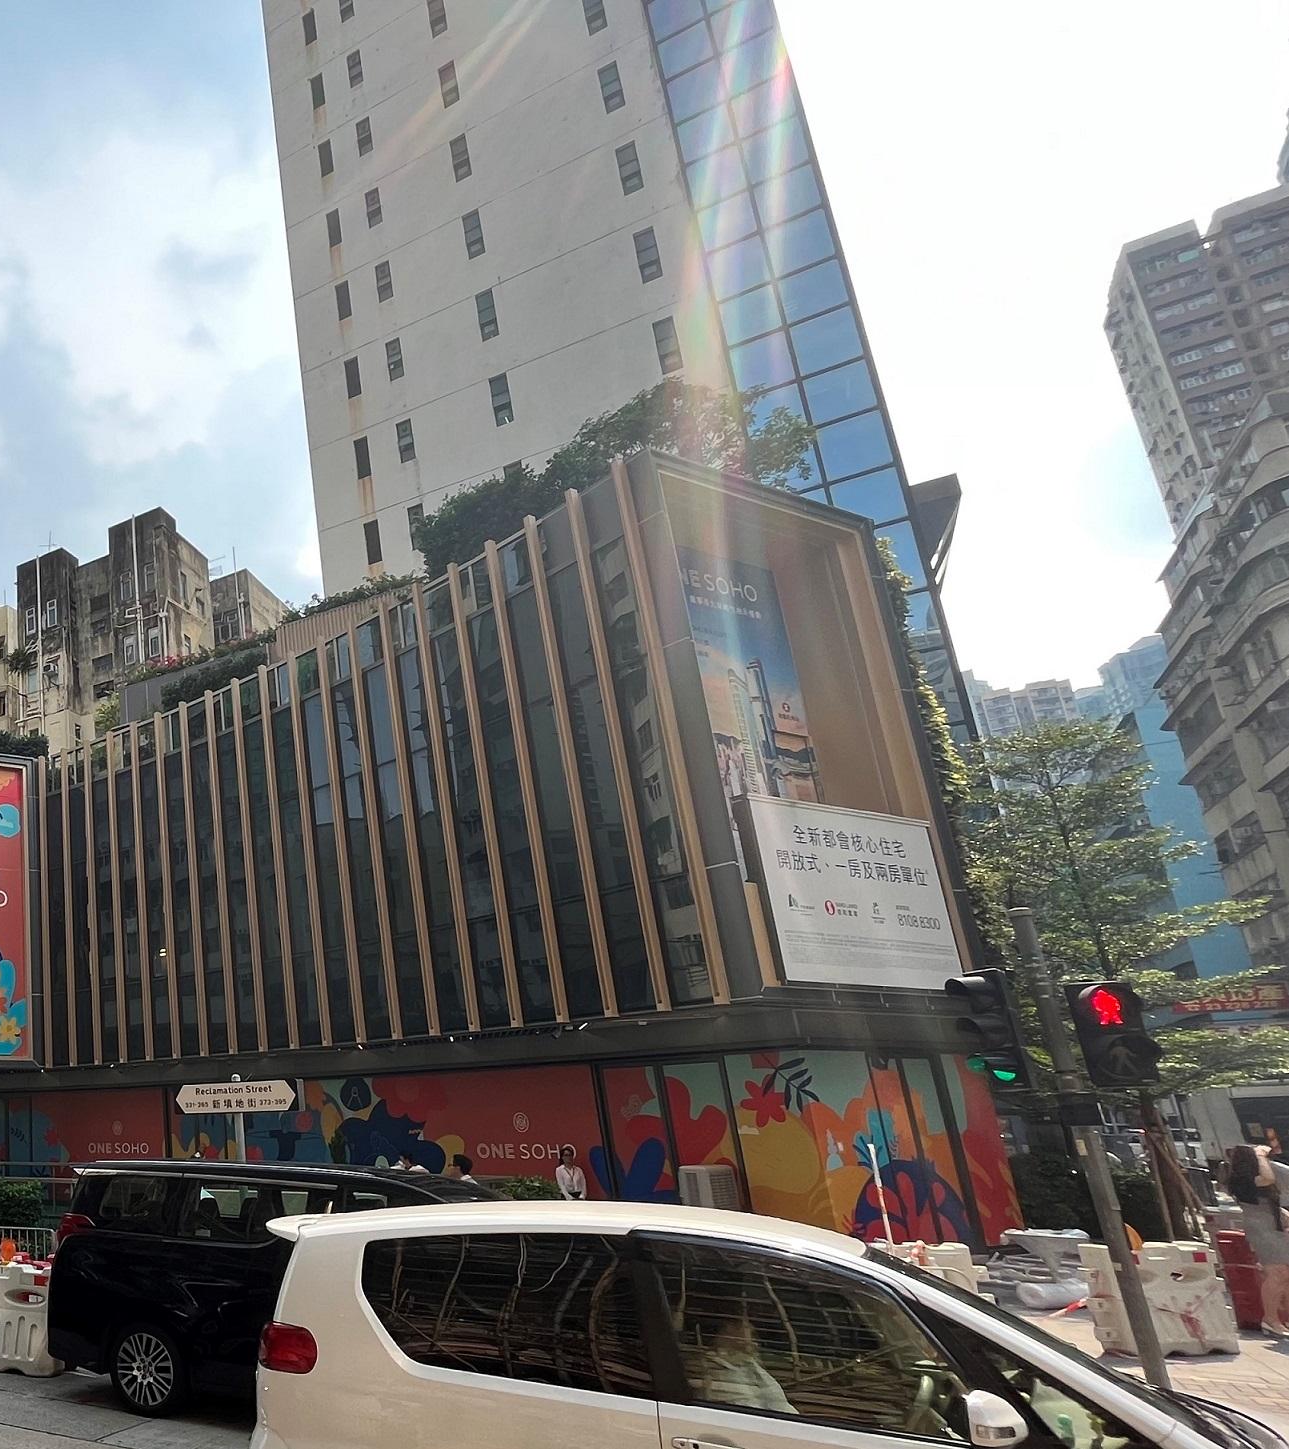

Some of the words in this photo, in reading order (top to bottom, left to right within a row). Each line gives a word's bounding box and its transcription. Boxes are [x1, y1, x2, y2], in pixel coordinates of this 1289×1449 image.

[703, 573, 758, 602] SOHO
[792, 824, 907, 859] 全新都會核心住宅
[897, 913, 919, 928] 8108
[919, 916, 941, 930] 8300
[195, 1086, 244, 1096] Reclamation
[245, 1085, 273, 1094] Street
[88, 1142, 112, 1154] ONE
[114, 1142, 149, 1154] SOHO
[476, 1143, 516, 1159] ONE
